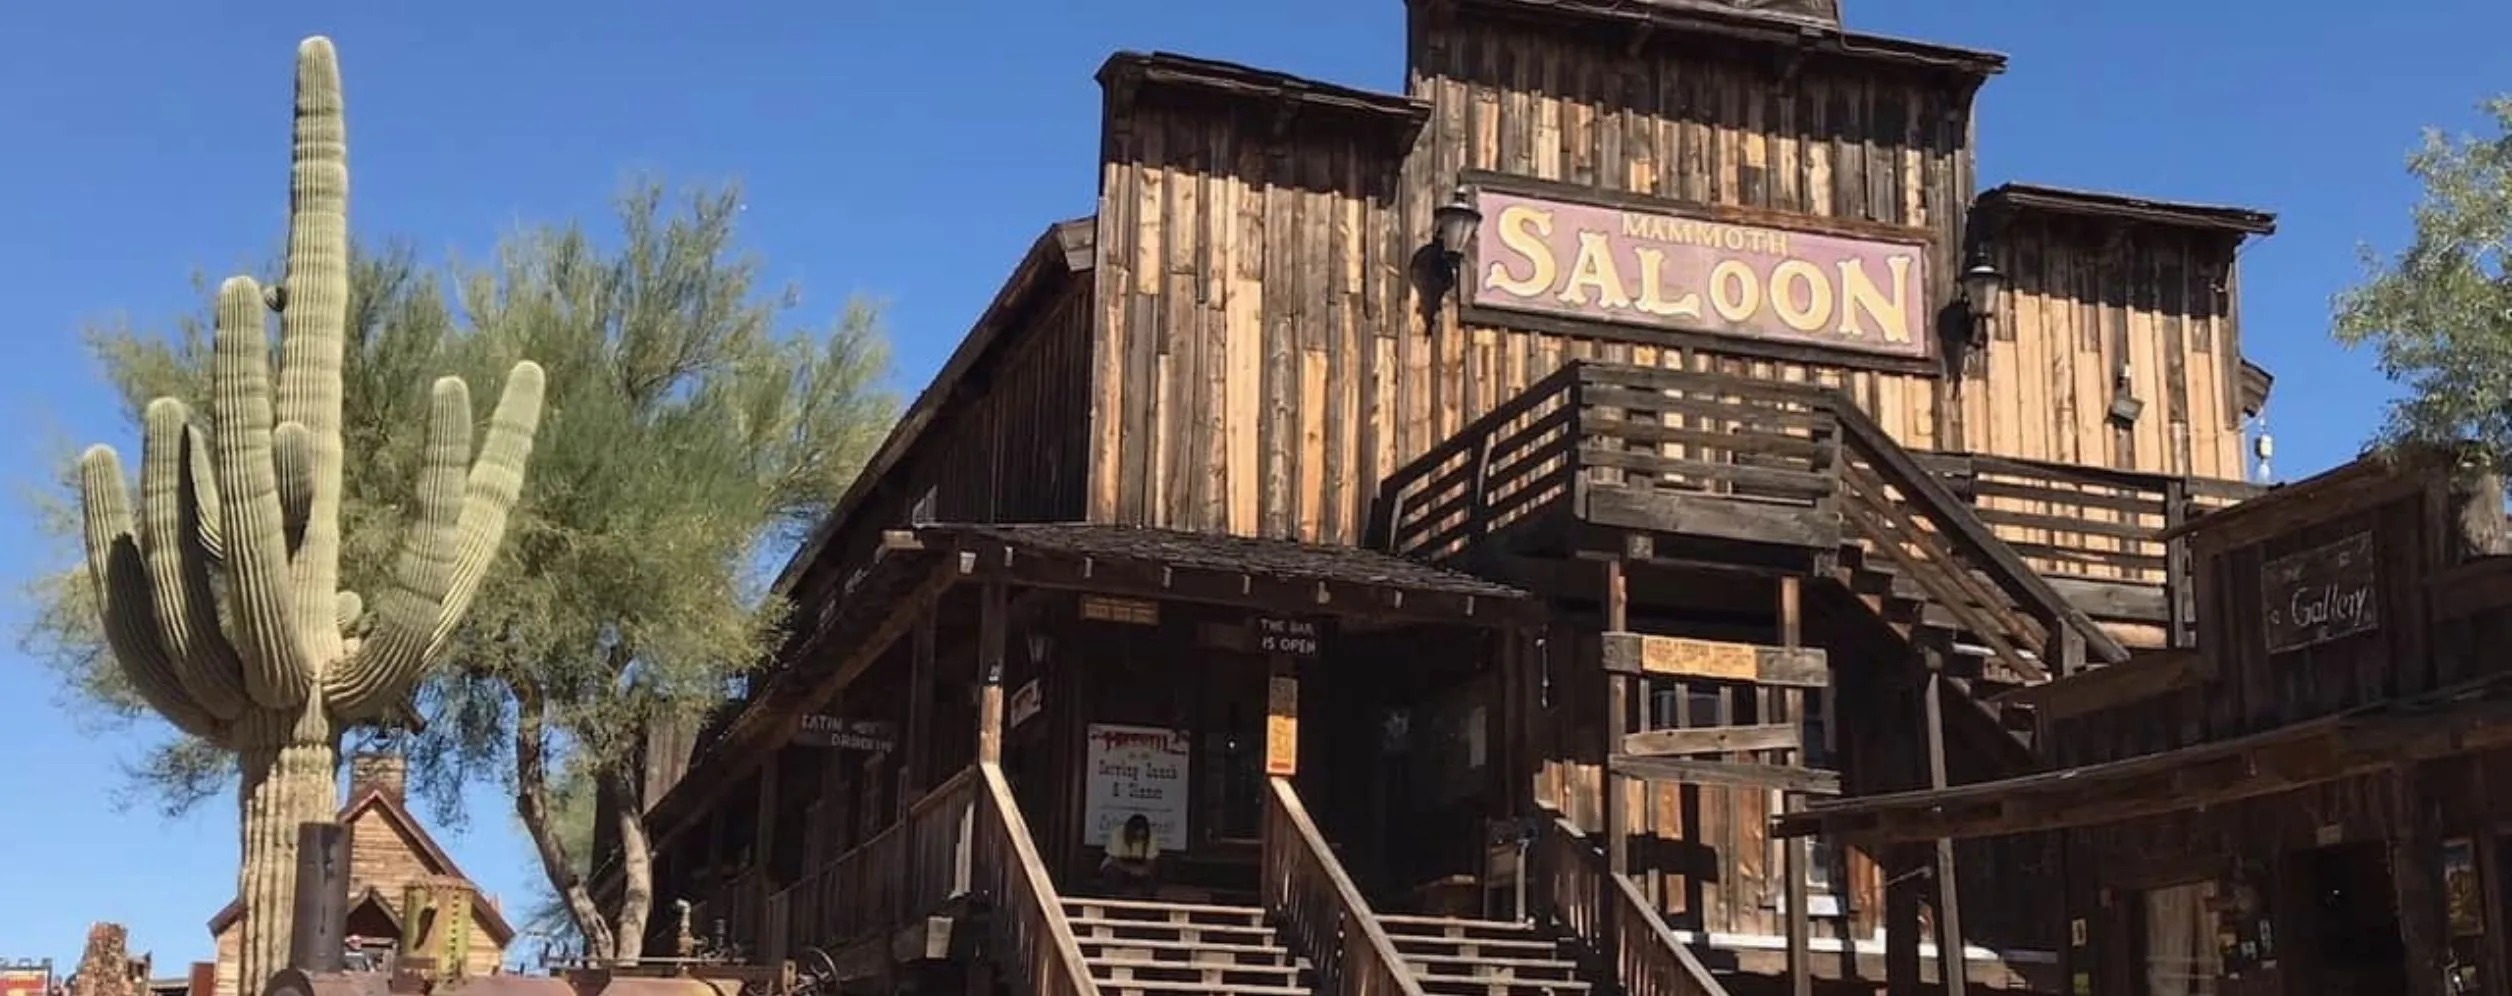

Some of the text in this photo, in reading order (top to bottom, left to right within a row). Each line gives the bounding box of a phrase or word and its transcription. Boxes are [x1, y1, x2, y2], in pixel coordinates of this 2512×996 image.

[1621, 213, 1790, 255] MAMMOTH
[1484, 206, 1912, 344] SALOON
[1260, 618, 1284, 632] THE
[2290, 583, 2368, 627] Gallery
[1262, 636, 1316, 655] IS OPEN
